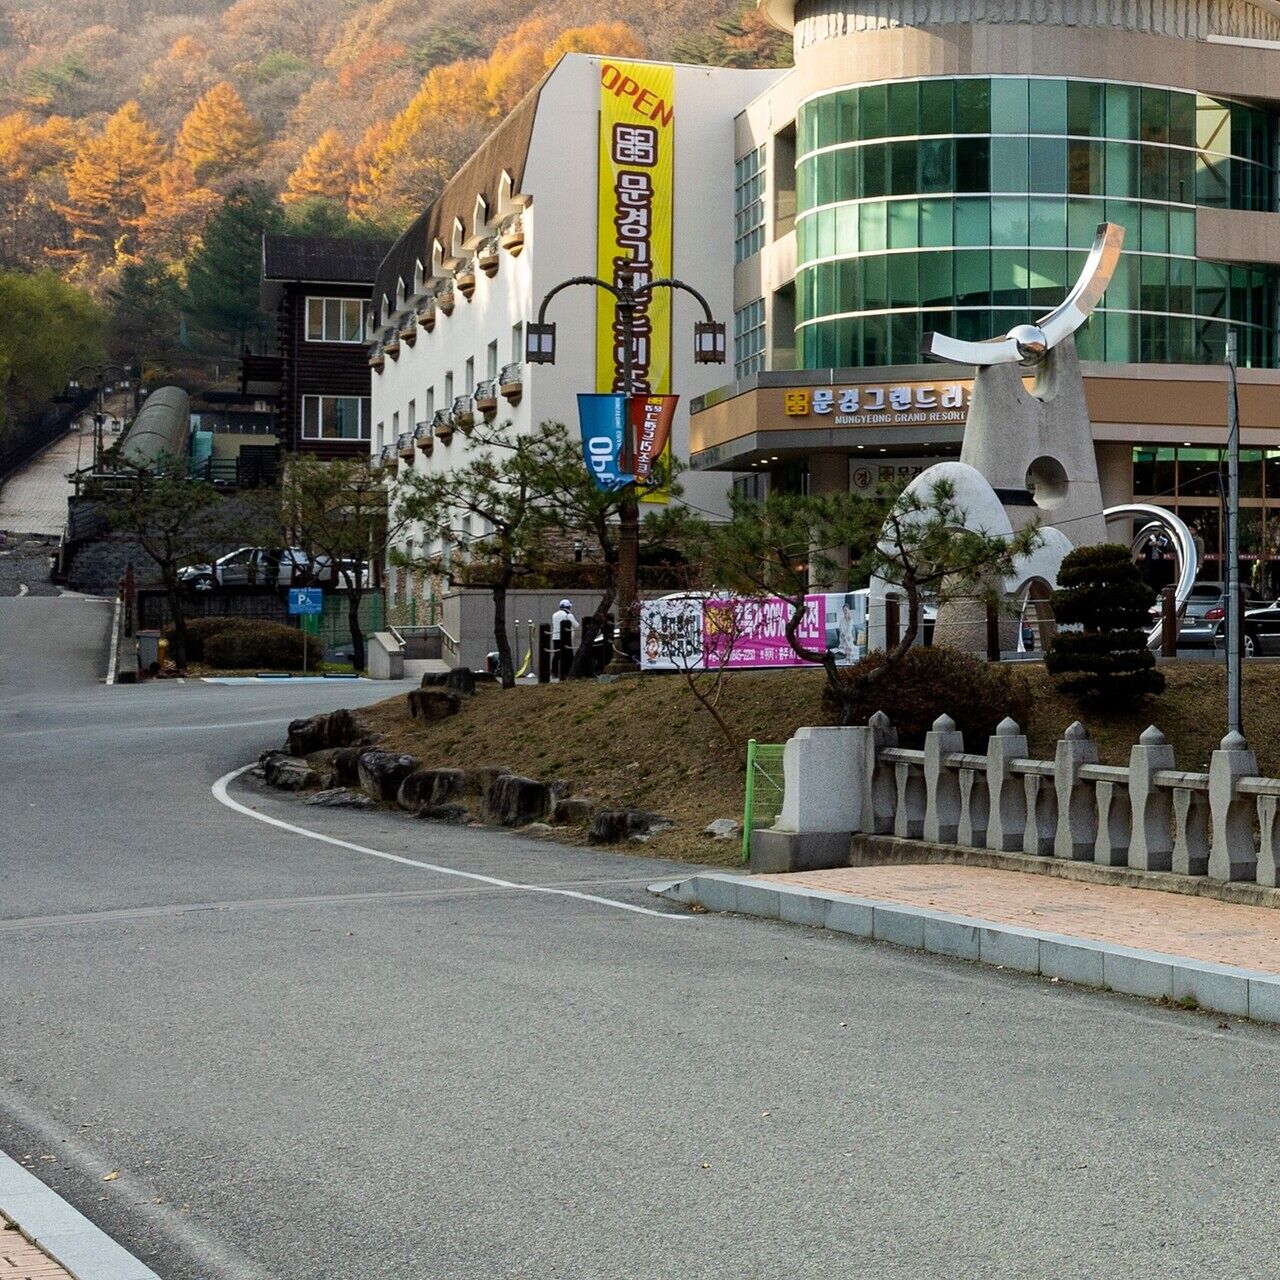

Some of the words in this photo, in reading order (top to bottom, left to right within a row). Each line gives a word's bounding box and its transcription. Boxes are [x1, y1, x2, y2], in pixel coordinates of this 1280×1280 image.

[601, 64, 674, 128] OPEN
[835, 414, 892, 424] MUNGYEONG
[895, 412, 927, 423] GRAND
[929, 410, 966, 421] RESORT
